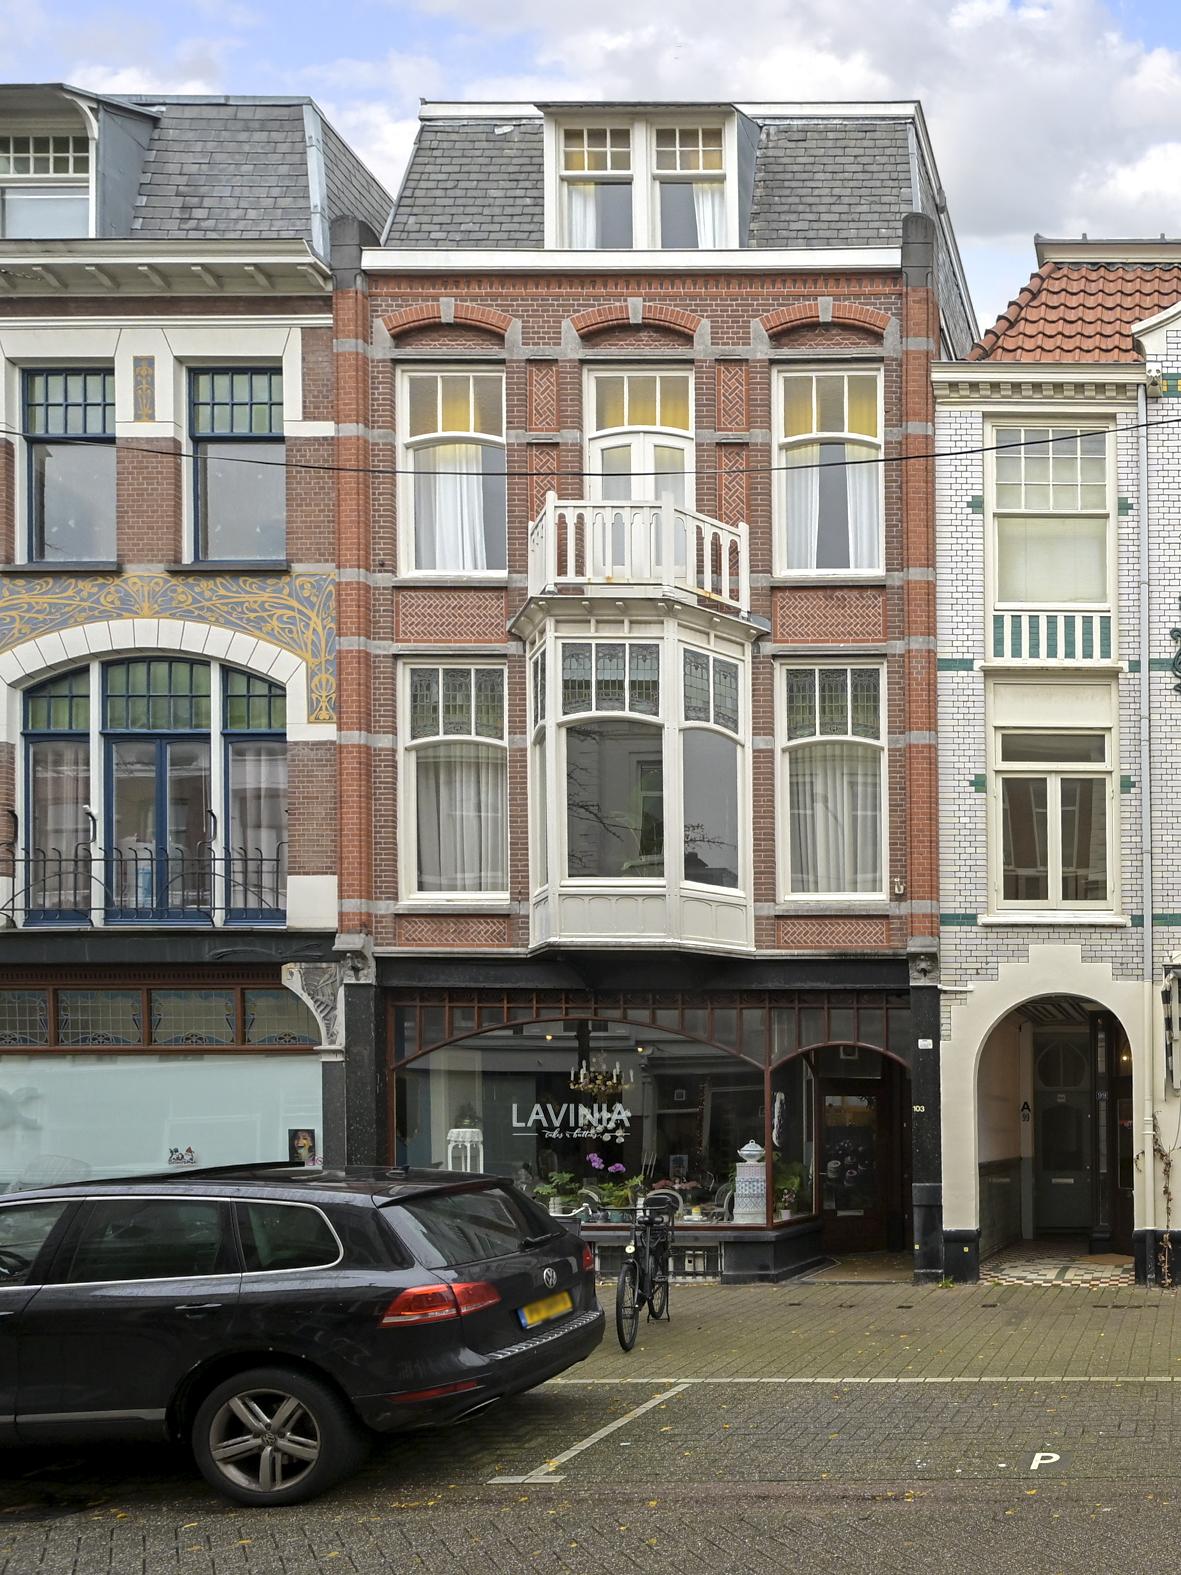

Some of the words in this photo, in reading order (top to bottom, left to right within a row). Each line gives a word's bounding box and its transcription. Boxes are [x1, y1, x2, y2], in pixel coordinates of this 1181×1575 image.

[512, 1103, 631, 1127] LAVINIA
[1021, 1101, 1031, 1112] A
[1030, 1452, 1060, 1470] P
